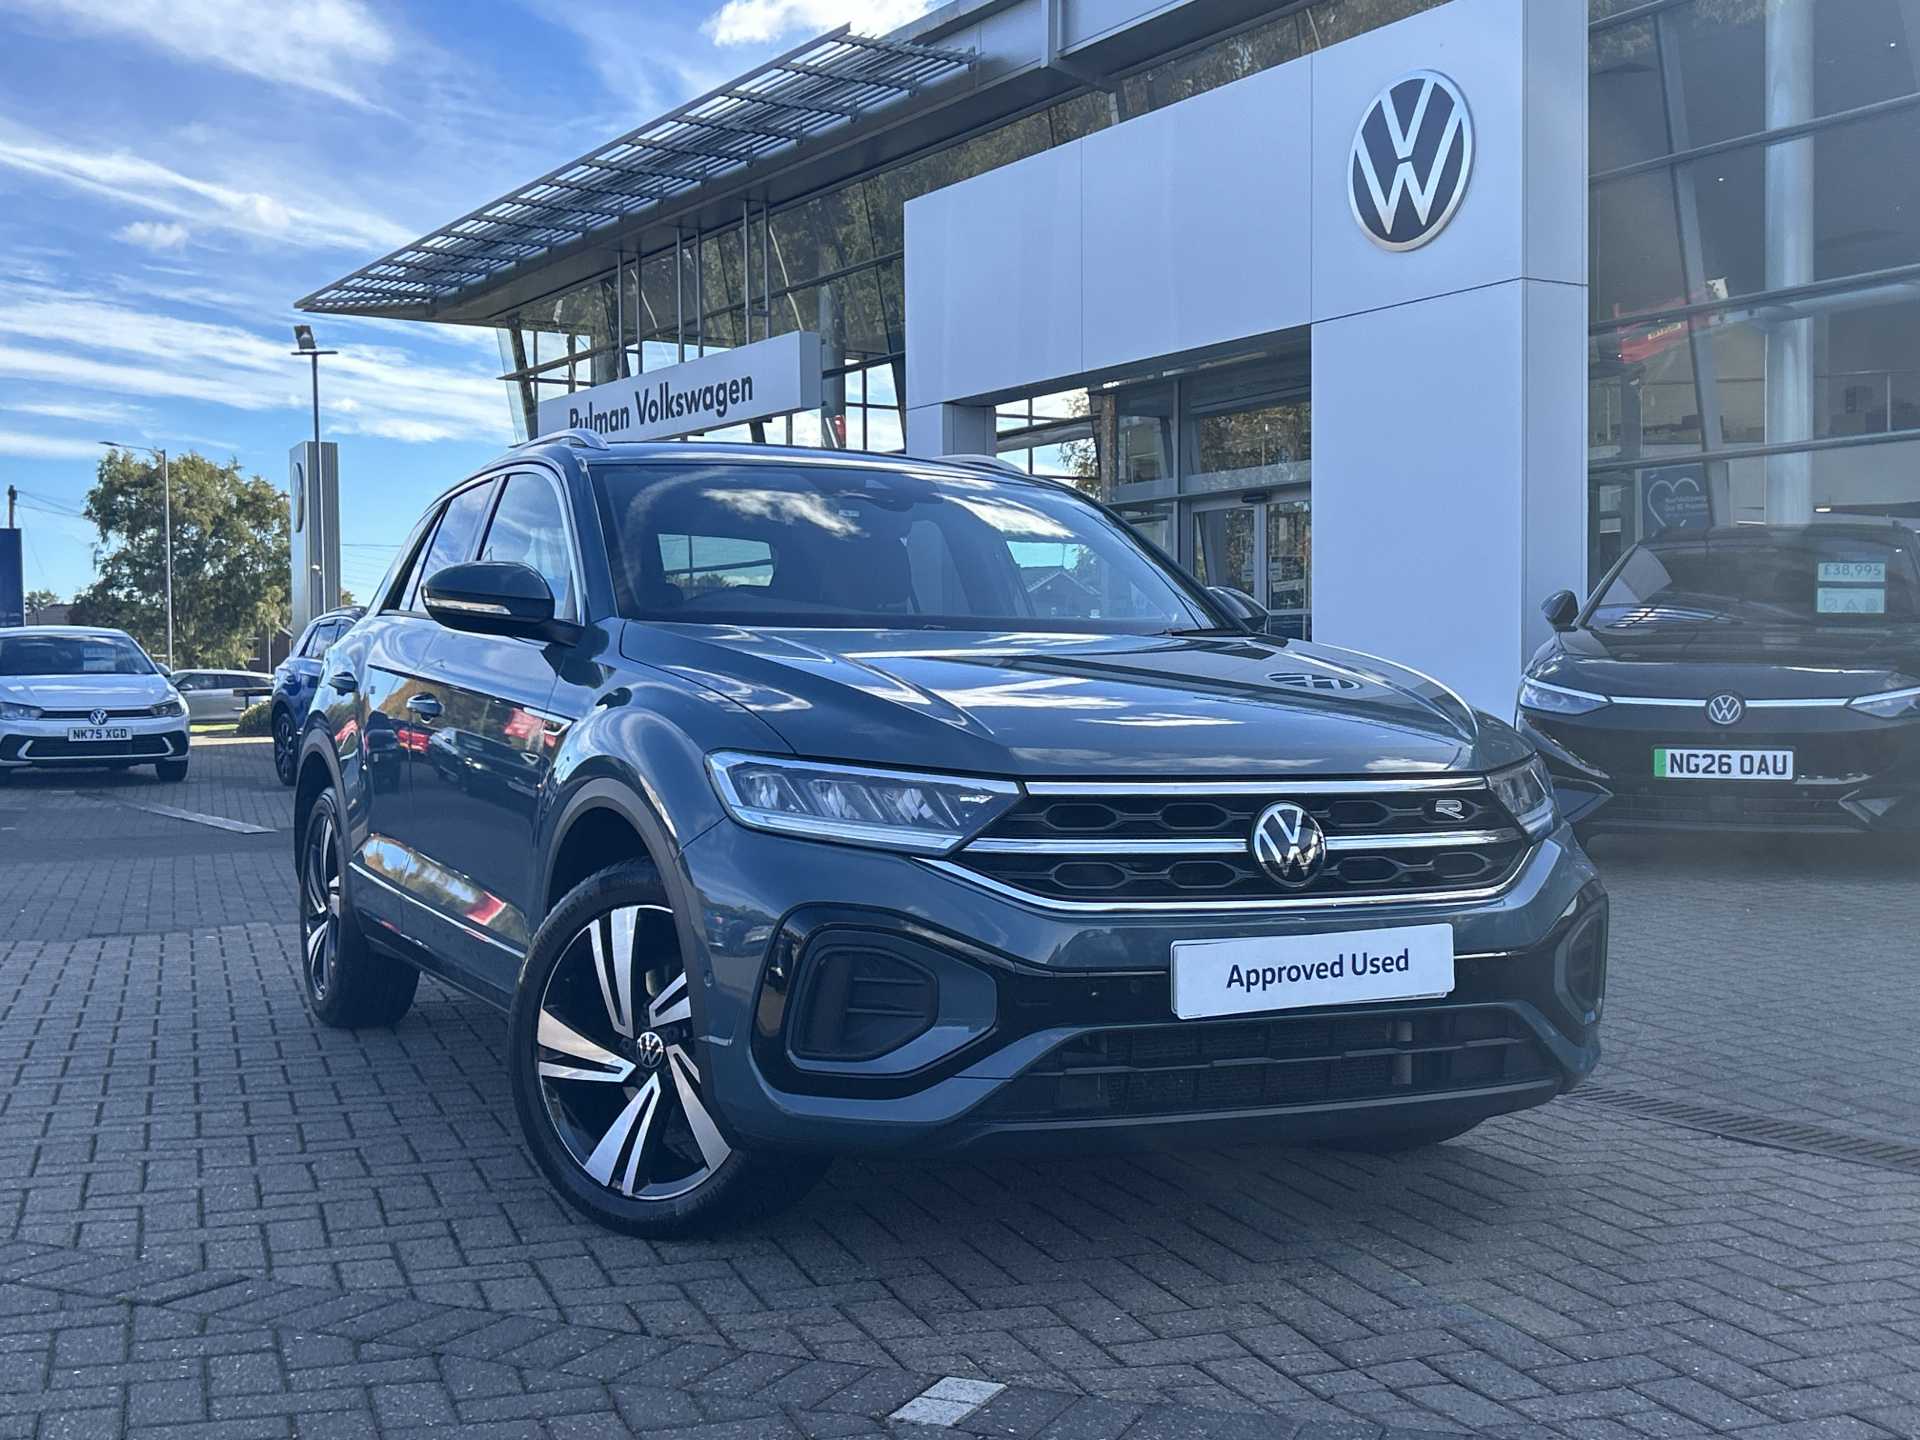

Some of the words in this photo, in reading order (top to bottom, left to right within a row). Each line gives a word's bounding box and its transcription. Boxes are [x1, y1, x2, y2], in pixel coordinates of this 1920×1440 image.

[569, 401, 630, 434] Pulman
[634, 375, 753, 425] Volkswagen
[1824, 564, 1881, 577] £38,995
[73, 729, 103, 740] NK75
[105, 728, 128, 739] XGD
[1669, 753, 1733, 775] NG26
[1740, 754, 1788, 776] OAU
[1226, 953, 1344, 993] Approved
[1351, 947, 1409, 977] Used
